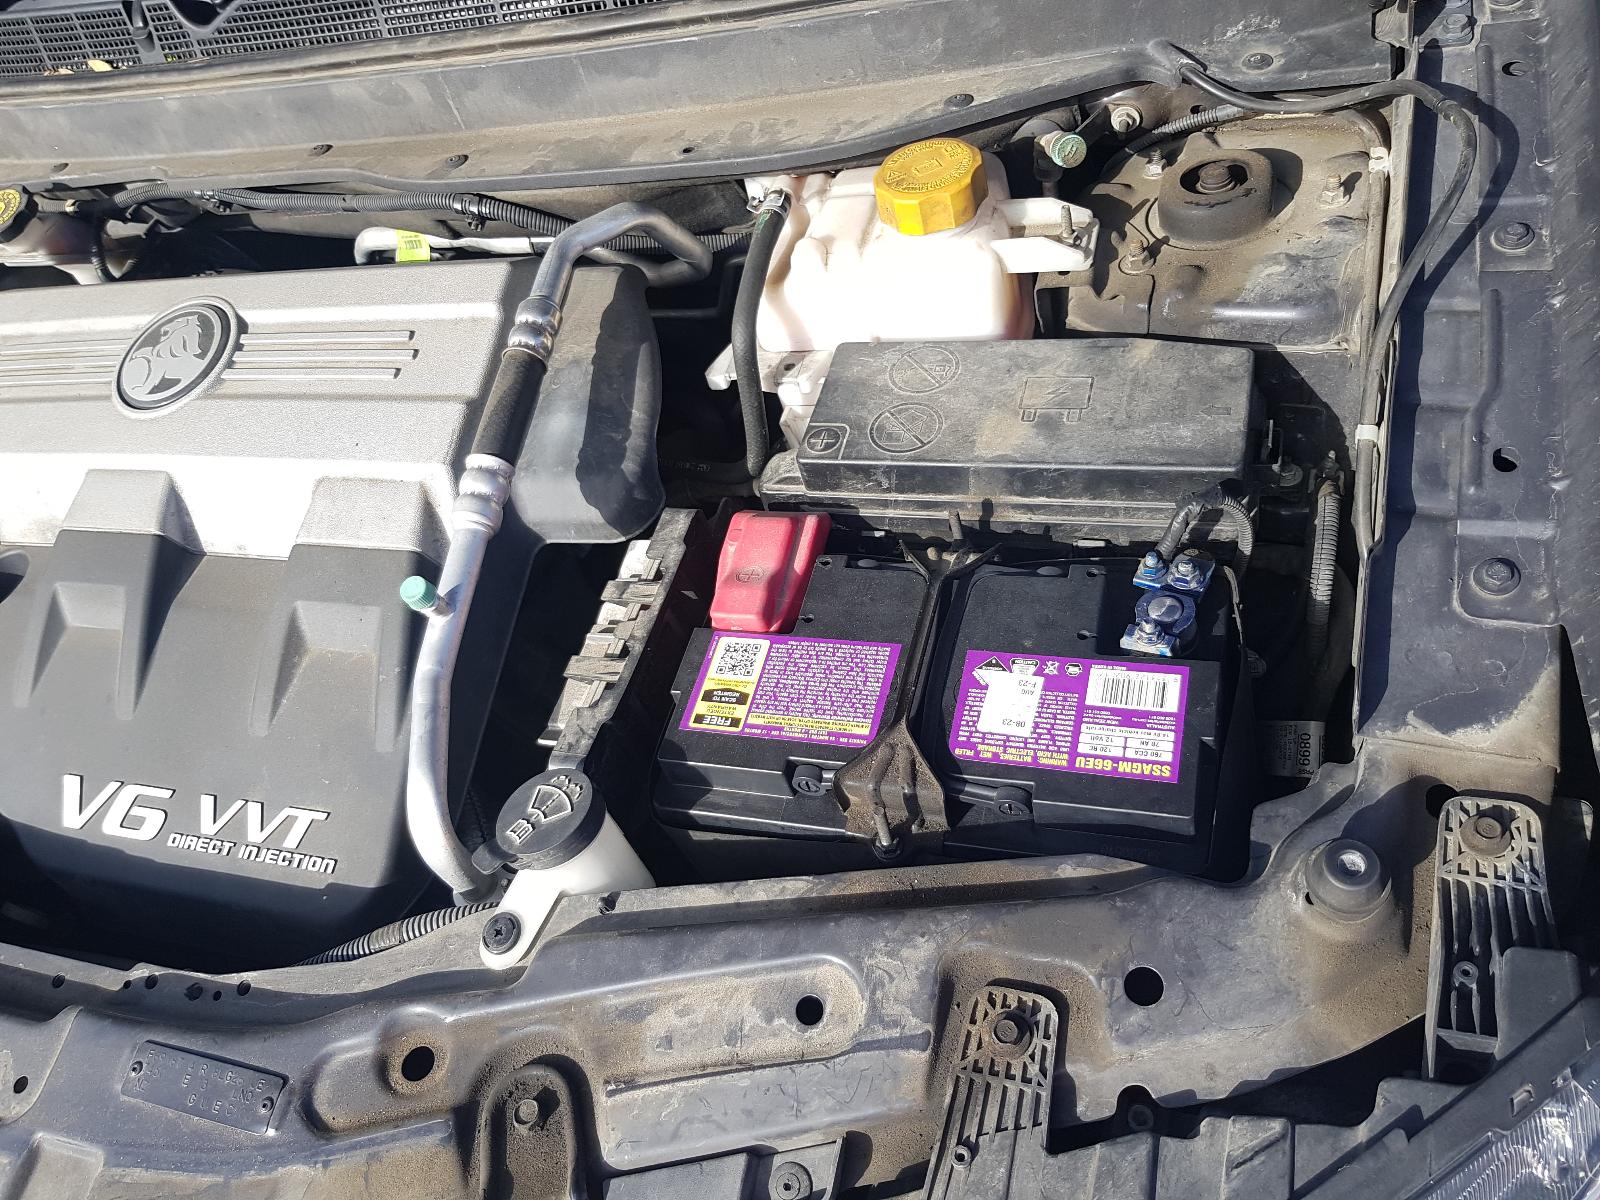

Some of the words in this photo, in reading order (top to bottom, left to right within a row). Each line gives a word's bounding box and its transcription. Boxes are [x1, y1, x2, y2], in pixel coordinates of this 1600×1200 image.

[703, 715, 732, 725] FREE
[1002, 718, 1026, 728] 08-23
[955, 748, 974, 756] FILLED
[1006, 748, 1034, 756] ELECTRIC
[1298, 732, 1311, 766] 0899
[1075, 756, 1171, 776] SSAGM-66EU
[62, 773, 176, 841] V6
[200, 793, 331, 849] VVT
[166, 832, 236, 856] DIRECT
[238, 844, 338, 875] INJECTION
